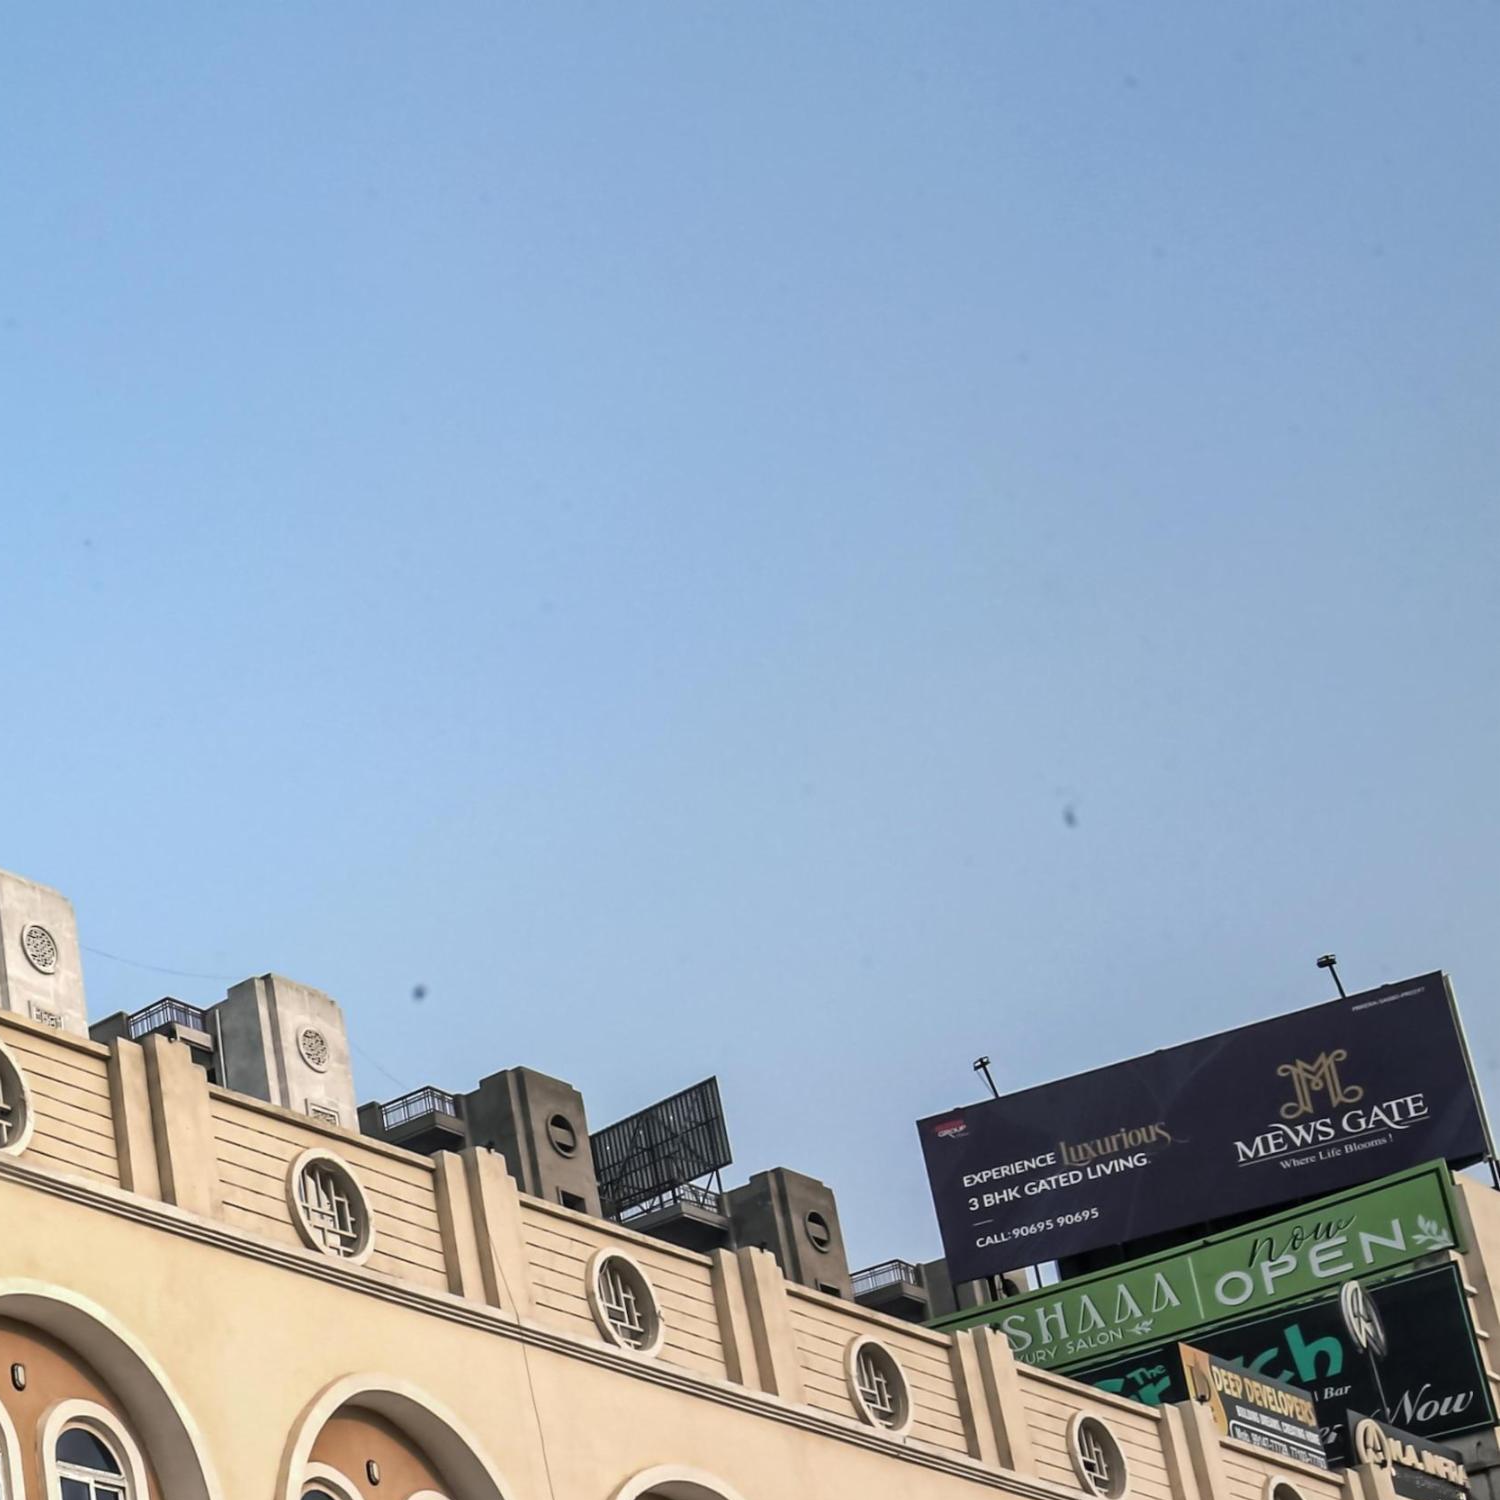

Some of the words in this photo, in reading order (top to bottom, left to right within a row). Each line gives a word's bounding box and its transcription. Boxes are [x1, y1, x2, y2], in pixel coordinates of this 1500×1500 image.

[1234, 1118, 1336, 1163] MEWS
[1341, 1093, 1430, 1131] GATE
[963, 1152, 1057, 1188] EXPERIENCE
[1058, 1121, 1172, 1166] Luxurious
[1280, 1154, 1316, 1170] Where
[1319, 1145, 1342, 1160] Life
[1345, 1137, 1387, 1154] Blooms
[968, 1198, 979, 1212] 3
[983, 1186, 1021, 1208] BHK
[1024, 1170, 1083, 1196] GATED
[1057, 1207, 1100, 1228] 90695
[1214, 1218, 1408, 1306] OPEN
[1066, 1327, 1124, 1354] SALON
[1323, 1384, 1352, 1401] Bar
